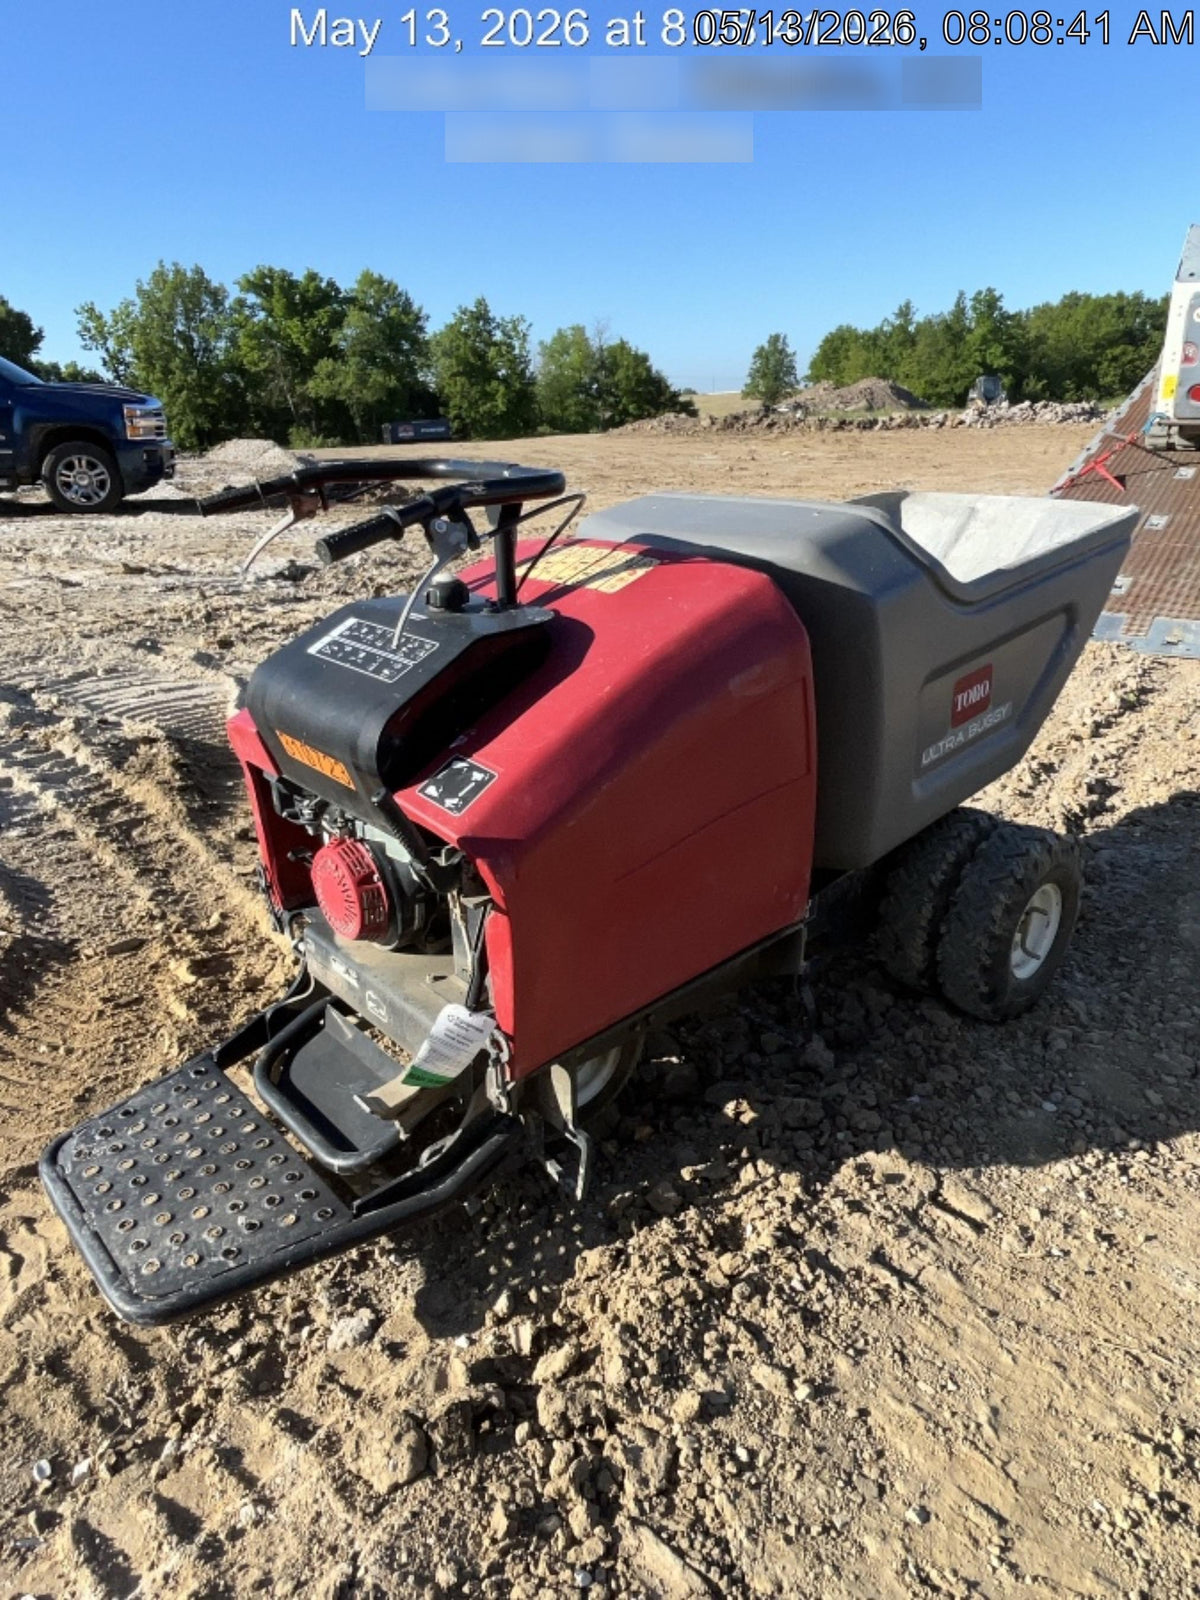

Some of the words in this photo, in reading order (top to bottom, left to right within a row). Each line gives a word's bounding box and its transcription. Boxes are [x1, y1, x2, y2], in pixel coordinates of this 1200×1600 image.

[955, 680, 991, 712] TORO
[921, 731, 965, 768] ULTRA
[967, 701, 1013, 740] BUGGY
